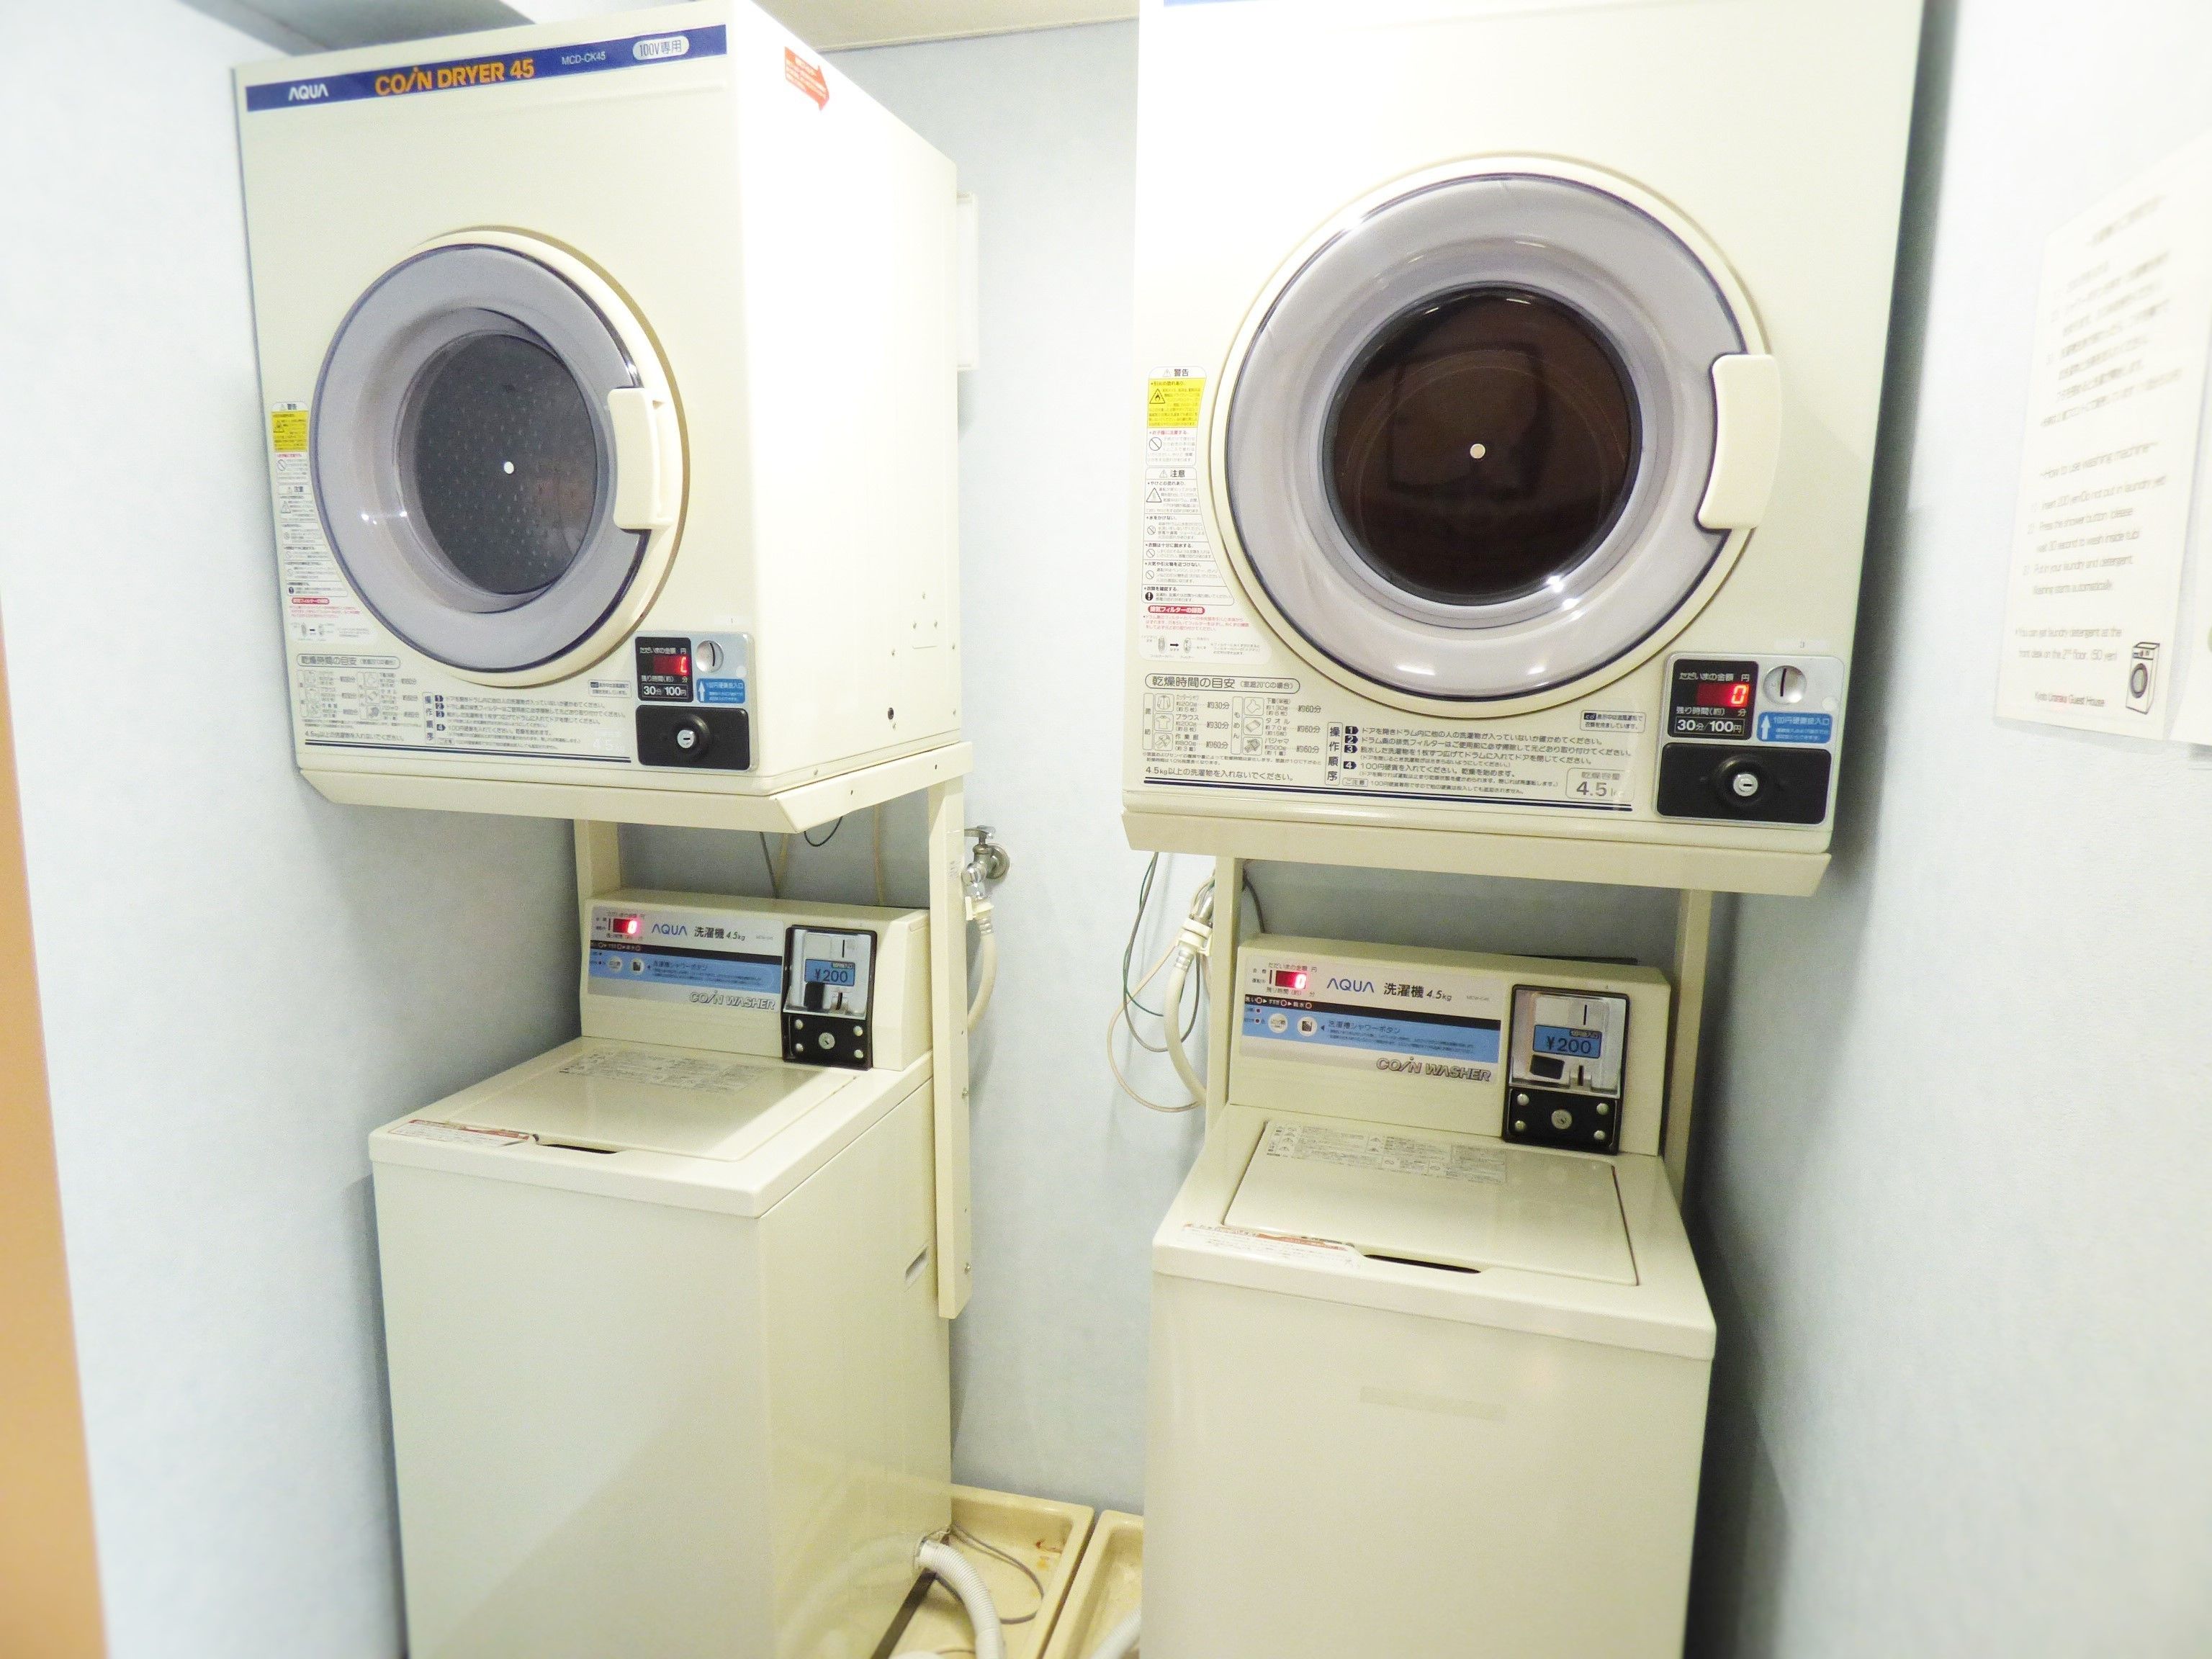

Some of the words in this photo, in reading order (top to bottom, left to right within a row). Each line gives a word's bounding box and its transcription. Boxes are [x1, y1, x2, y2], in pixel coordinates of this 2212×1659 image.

[639, 39, 683, 57] 100V専用
[561, 51, 607, 66] MCD-CK45
[436, 60, 504, 89] DRYER
[509, 59, 535, 80] 45
[287, 84, 330, 102] AQUA
[1174, 368, 1190, 377] 警告
[1170, 469, 1185, 478] 注意
[1152, 676, 1236, 688] 乾燥時間の目安
[1740, 673, 1750, 682] 円
[1730, 684, 1747, 705] 0
[1737, 709, 1747, 717] 分
[1575, 781, 1606, 797] 4.5
[651, 922, 688, 936] AQUA
[694, 926, 724, 940] 洗濯機
[814, 968, 848, 984] ¥200
[1326, 977, 1375, 993] AQUA
[1383, 982, 1424, 999] 洗濯機
[1426, 989, 1453, 1002] 4.5kg
[725, 996, 776, 1011] WASHER
[1546, 1035, 1592, 1054] ¥200
[1425, 1063, 1493, 1082] WASHER
